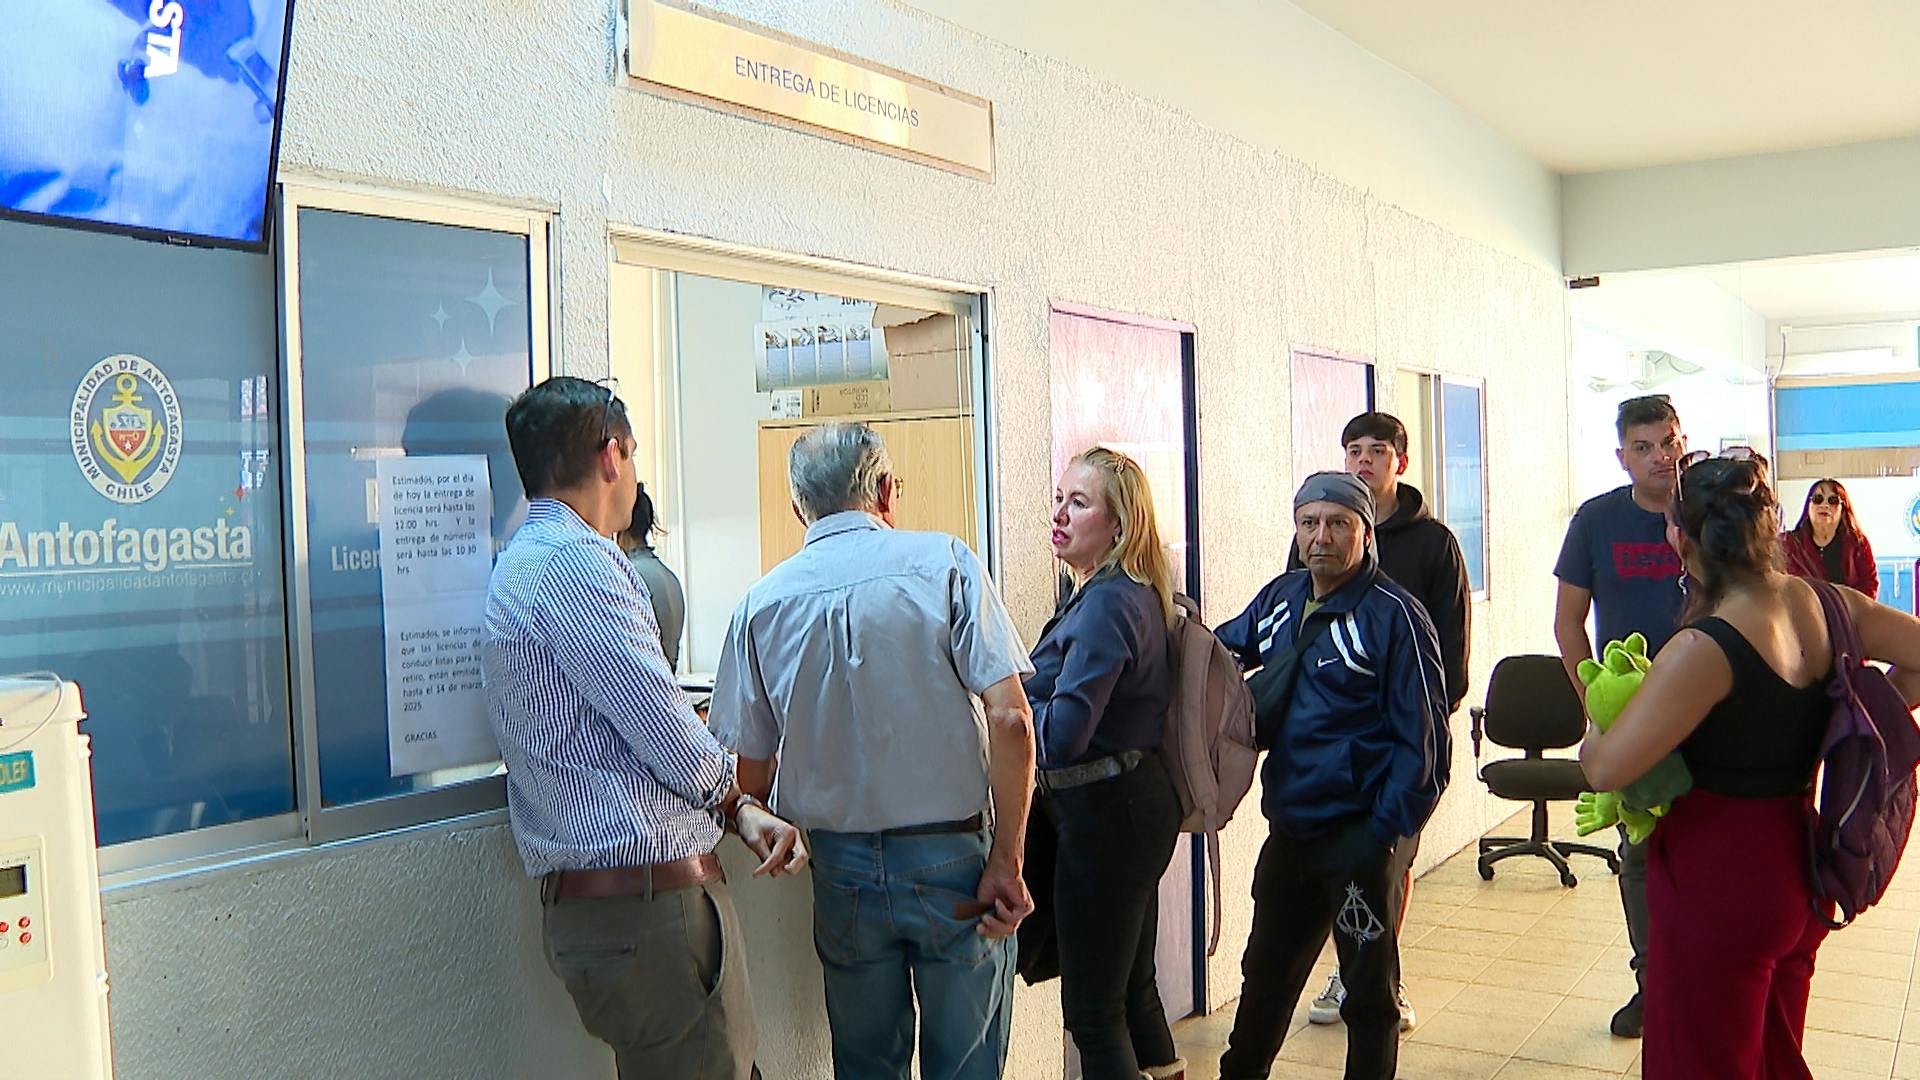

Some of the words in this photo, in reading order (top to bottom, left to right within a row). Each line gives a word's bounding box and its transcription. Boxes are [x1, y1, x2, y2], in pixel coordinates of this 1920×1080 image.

[735, 55, 815, 97] ENTREGA
[819, 81, 840, 103] DE
[844, 88, 920, 128] LICENCIAS
[73, 363, 114, 481] MUNICIPALIDAD
[118, 359, 139, 372] DE
[143, 368, 181, 475] ANTOFAGASTA
[437, 475, 450, 486] por
[453, 473, 460, 483] el
[105, 481, 154, 500] CHILE
[393, 491, 403, 500] de
[406, 490, 421, 501] hoy
[424, 489, 431, 499] la
[434, 489, 463, 499] entrega
[465, 488, 475, 498] de
[394, 505, 423, 515] licencia
[425, 504, 441, 514] será
[443, 503, 463, 513] hasta
[465, 501, 475, 512] las
[468, 516, 475, 525] la
[0, 517, 251, 573] Antofagasta
[395, 535, 426, 545] entrega
[430, 532, 440, 543] de
[331, 545, 381, 572] Licen
[396, 549, 413, 560] será
[417, 548, 438, 559] hasta
[442, 629, 451, 638] se
[453, 626, 481, 636] informa
[401, 646, 416, 656] que
[421, 643, 432, 653] las
[436, 641, 467, 651] licencias
[472, 638, 481, 648] de
[401, 658, 433, 670] conducir
[455, 655, 471, 665] para
[402, 687, 423, 698] hasta
[426, 685, 433, 695] el
[436, 684, 445, 693] 14
[448, 683, 458, 693] de
[460, 681, 483, 691] marzo
[404, 730, 437, 744] GRACIAS
